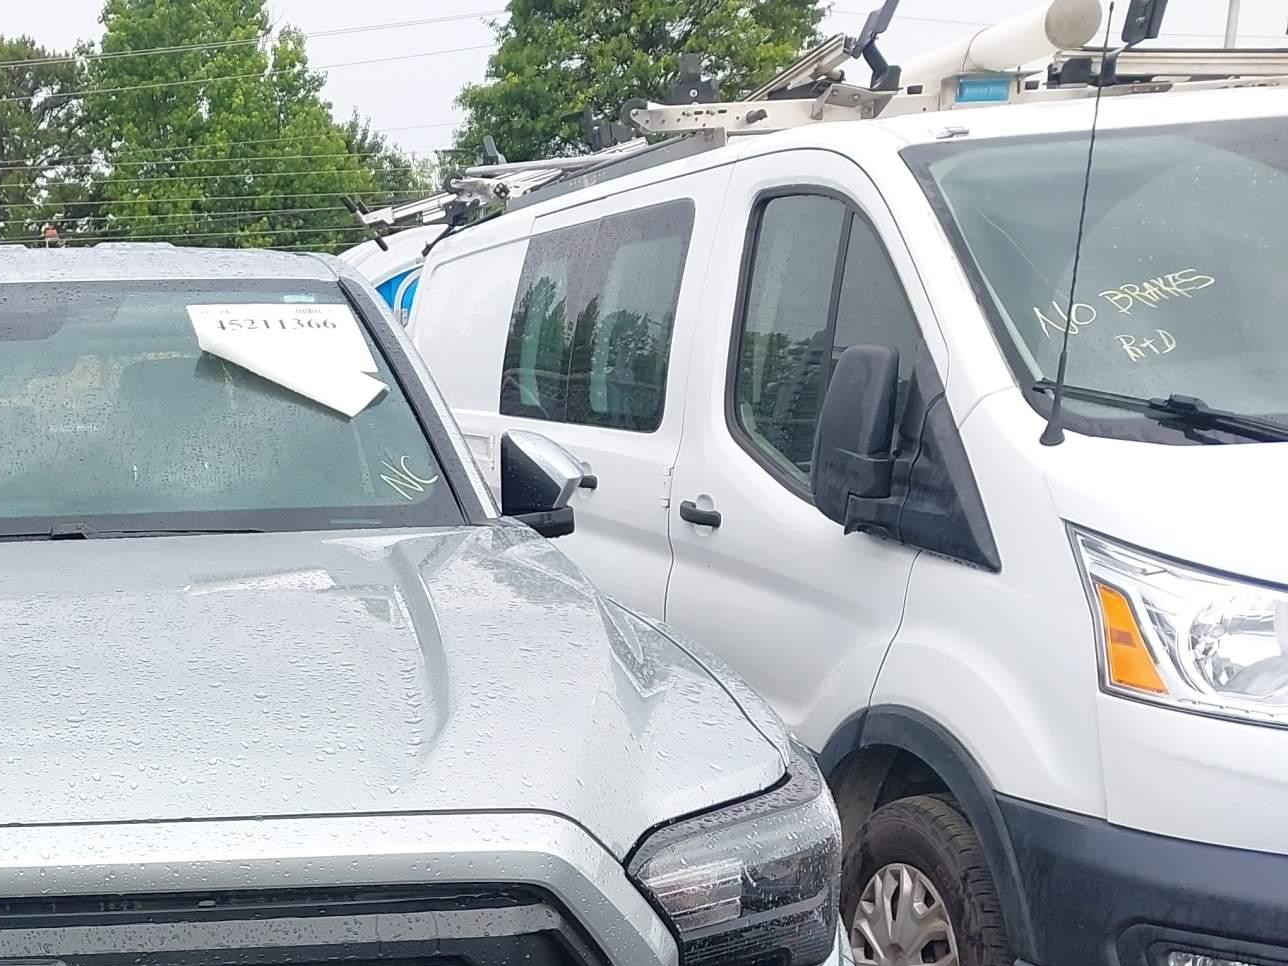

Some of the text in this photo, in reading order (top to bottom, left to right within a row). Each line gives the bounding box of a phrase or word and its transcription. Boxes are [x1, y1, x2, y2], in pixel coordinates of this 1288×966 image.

[1032, 268, 1215, 339] NO BRAKES
[379, 455, 439, 500] NC
